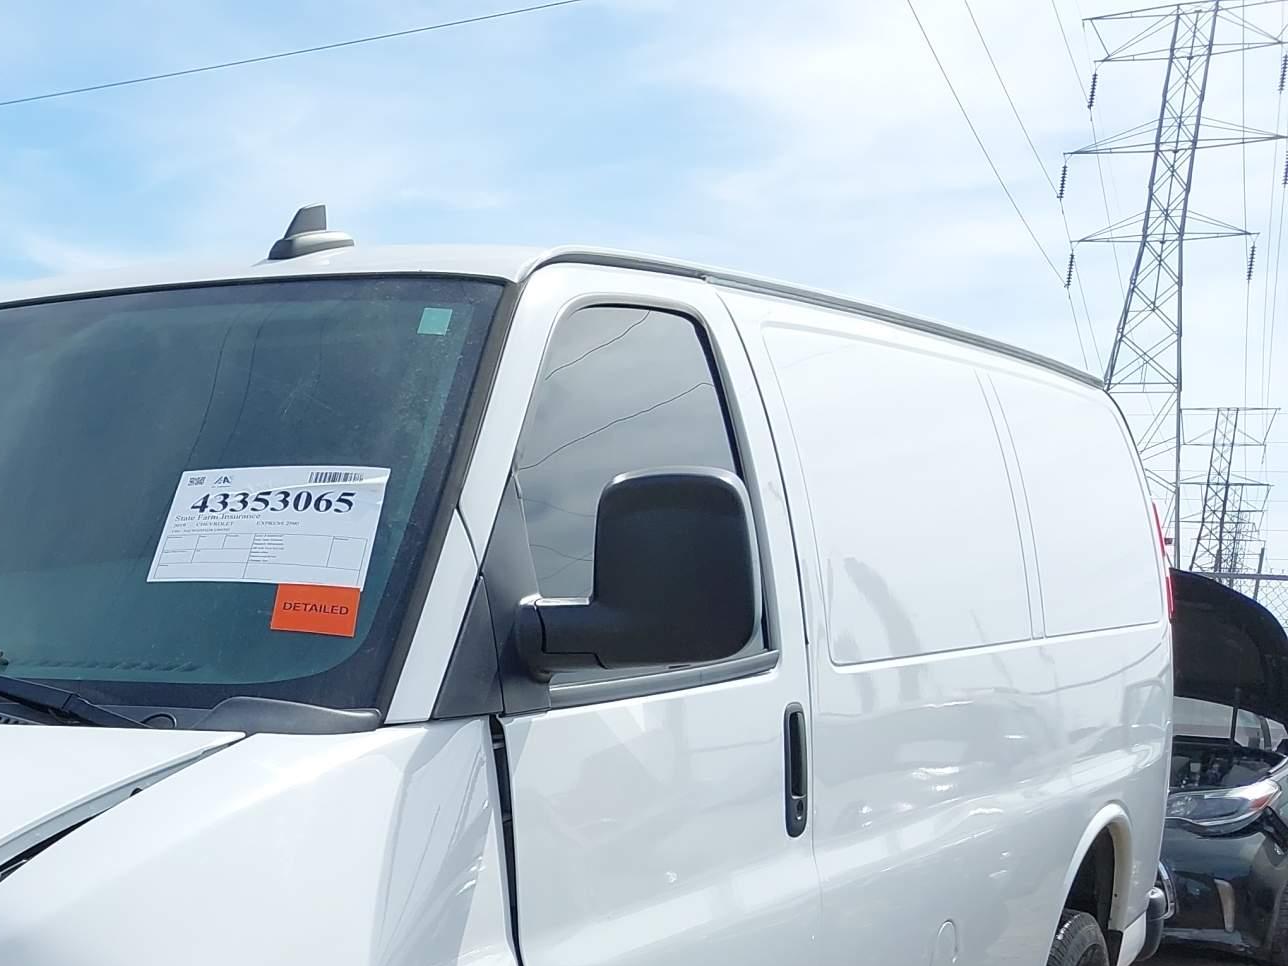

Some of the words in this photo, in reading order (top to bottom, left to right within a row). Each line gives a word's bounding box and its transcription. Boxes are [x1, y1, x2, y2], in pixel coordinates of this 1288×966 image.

[191, 490, 356, 513] 43353065
[197, 513, 219, 521] Farm
[282, 602, 349, 615] DETAILED
